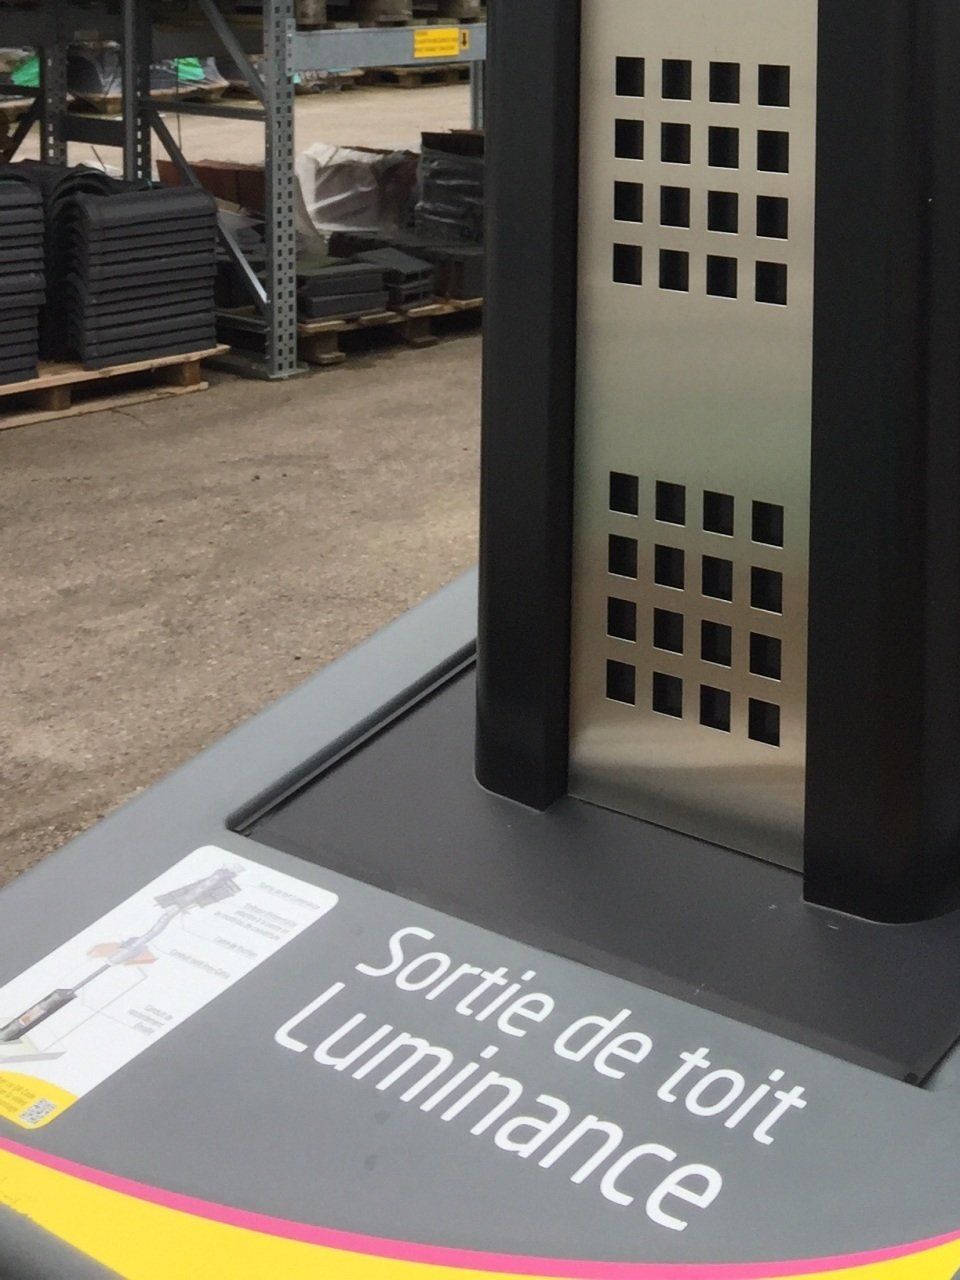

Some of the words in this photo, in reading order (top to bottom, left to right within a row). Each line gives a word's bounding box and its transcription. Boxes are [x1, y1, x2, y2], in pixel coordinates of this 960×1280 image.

[274, 982, 723, 1231] Luminance
[355, 927, 555, 1037] Sortie
[553, 1009, 652, 1080] de
[657, 1047, 807, 1145] toit
